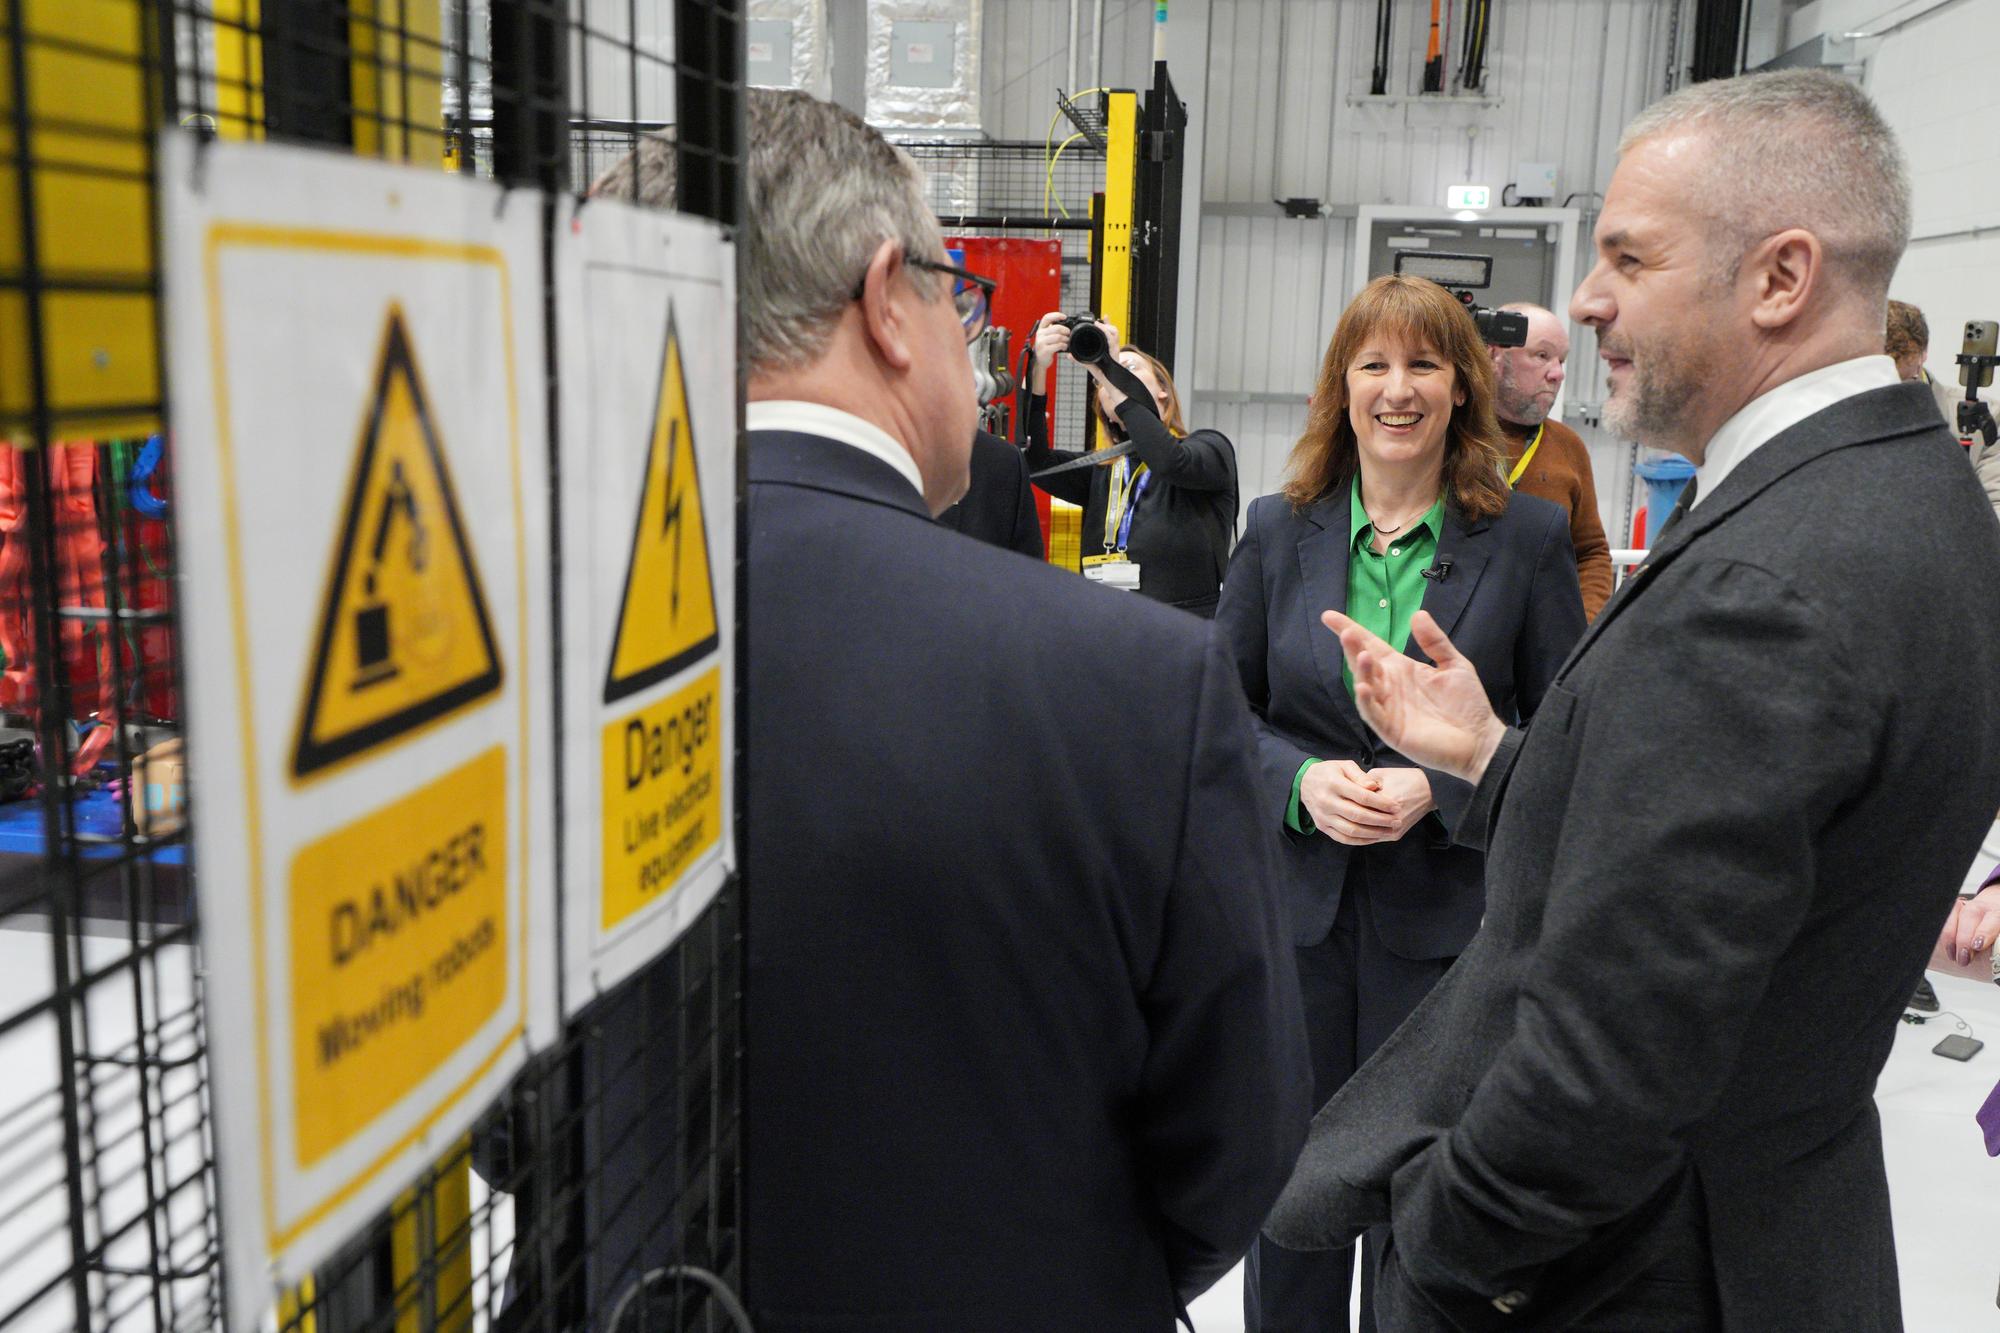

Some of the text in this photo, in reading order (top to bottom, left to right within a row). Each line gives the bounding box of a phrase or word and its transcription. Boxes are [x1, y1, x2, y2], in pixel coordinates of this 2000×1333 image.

[626, 691, 712, 790] Danger
[625, 811, 659, 853] Live
[639, 814, 704, 891] equipment
[330, 822, 486, 968] DANGER
[317, 917, 497, 1067] Moving robots
